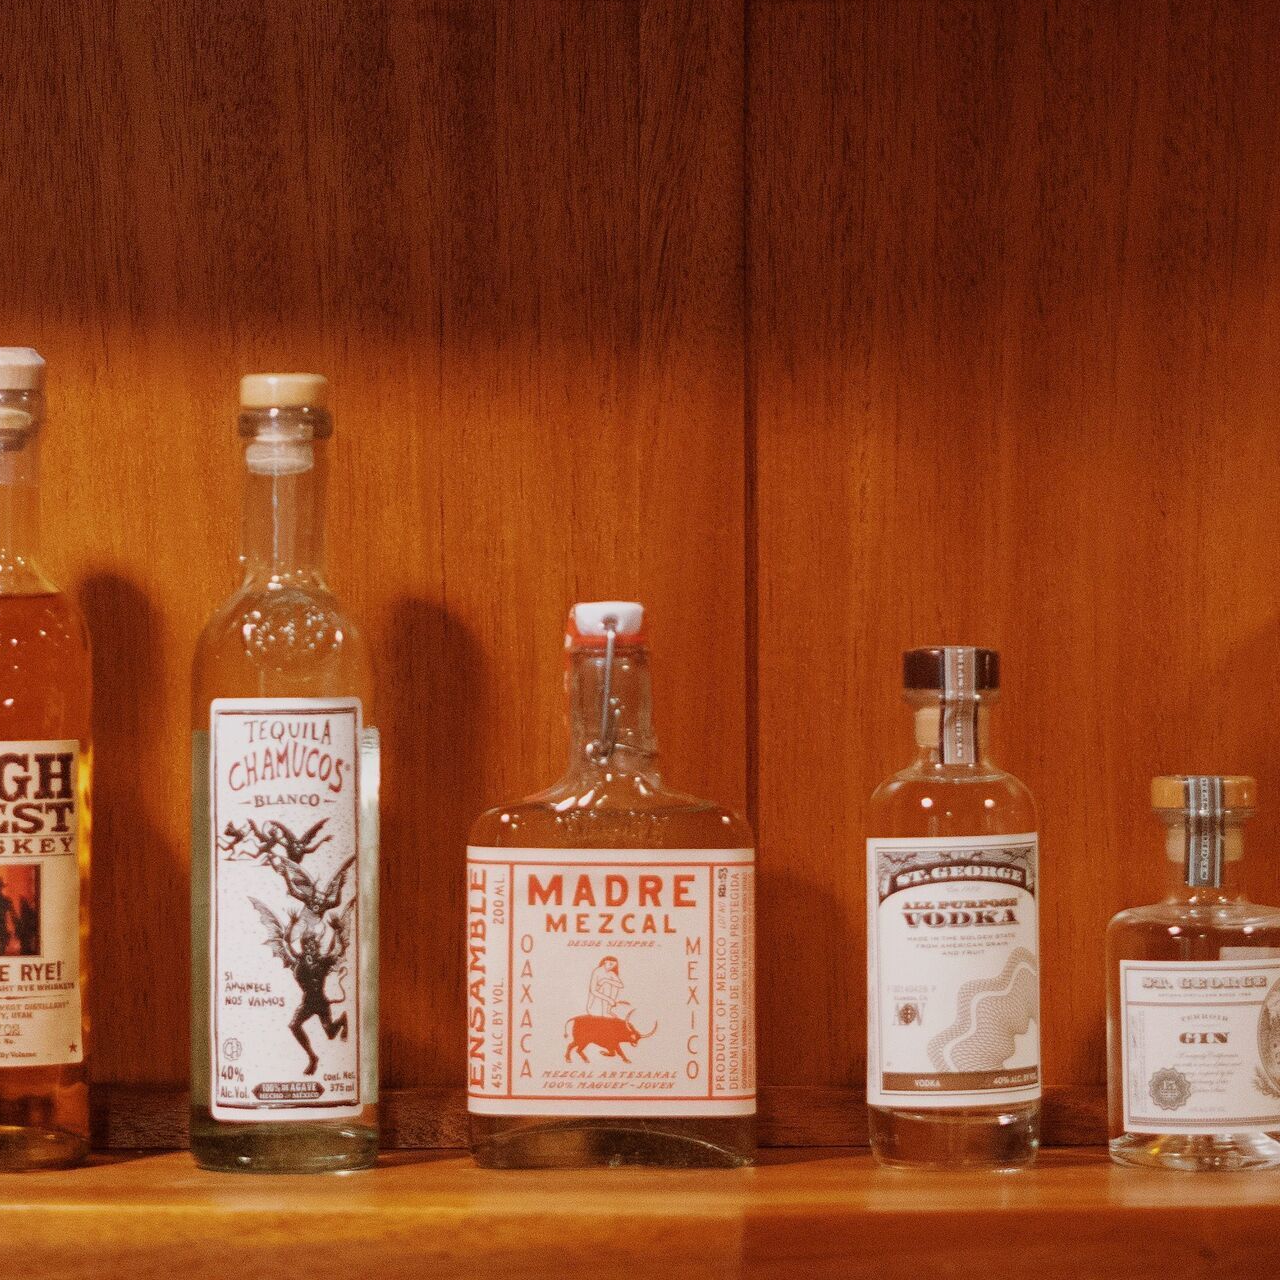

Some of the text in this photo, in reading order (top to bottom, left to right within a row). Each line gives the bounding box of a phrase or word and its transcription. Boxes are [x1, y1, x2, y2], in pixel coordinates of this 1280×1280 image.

[243, 719, 332, 745] TEQUILA
[228, 741, 344, 794] CHAMUCOS
[254, 793, 321, 808] BLANCO
[527, 873, 697, 908] MADRE
[902, 897, 1018, 910] ALL PURPOSE
[493, 900, 505, 925] 200
[902, 908, 1020, 929] VODKA
[545, 912, 677, 934] MEZCAL
[21, 960, 62, 982] RYE!
[716, 936, 727, 992] MEXICO
[224, 971, 233, 981] SI
[469, 868, 487, 1090] ENSAMBLE
[729, 872, 740, 1090] DENOMINACION DE ORIGEN PROTEGIDA
[17, 983, 35, 992] RYE
[224, 981, 272, 994] AMANECE
[224, 997, 286, 1008] NOS VAMOS
[715, 998, 726, 1018] OF
[492, 1009, 504, 1026] BY
[1178, 1031, 1231, 1045] GIN
[715, 1023, 726, 1091] PRODUCT
[221, 1065, 245, 1082] 40%
[491, 1062, 503, 1089] 45%
[542, 1070, 679, 1079] MEZCAL ARTESANAL
[291, 1082, 318, 1092] AGAVE
[329, 1083, 345, 1092] 375
[542, 1081, 574, 1089] 100%
[914, 1079, 941, 1088] VODKA
